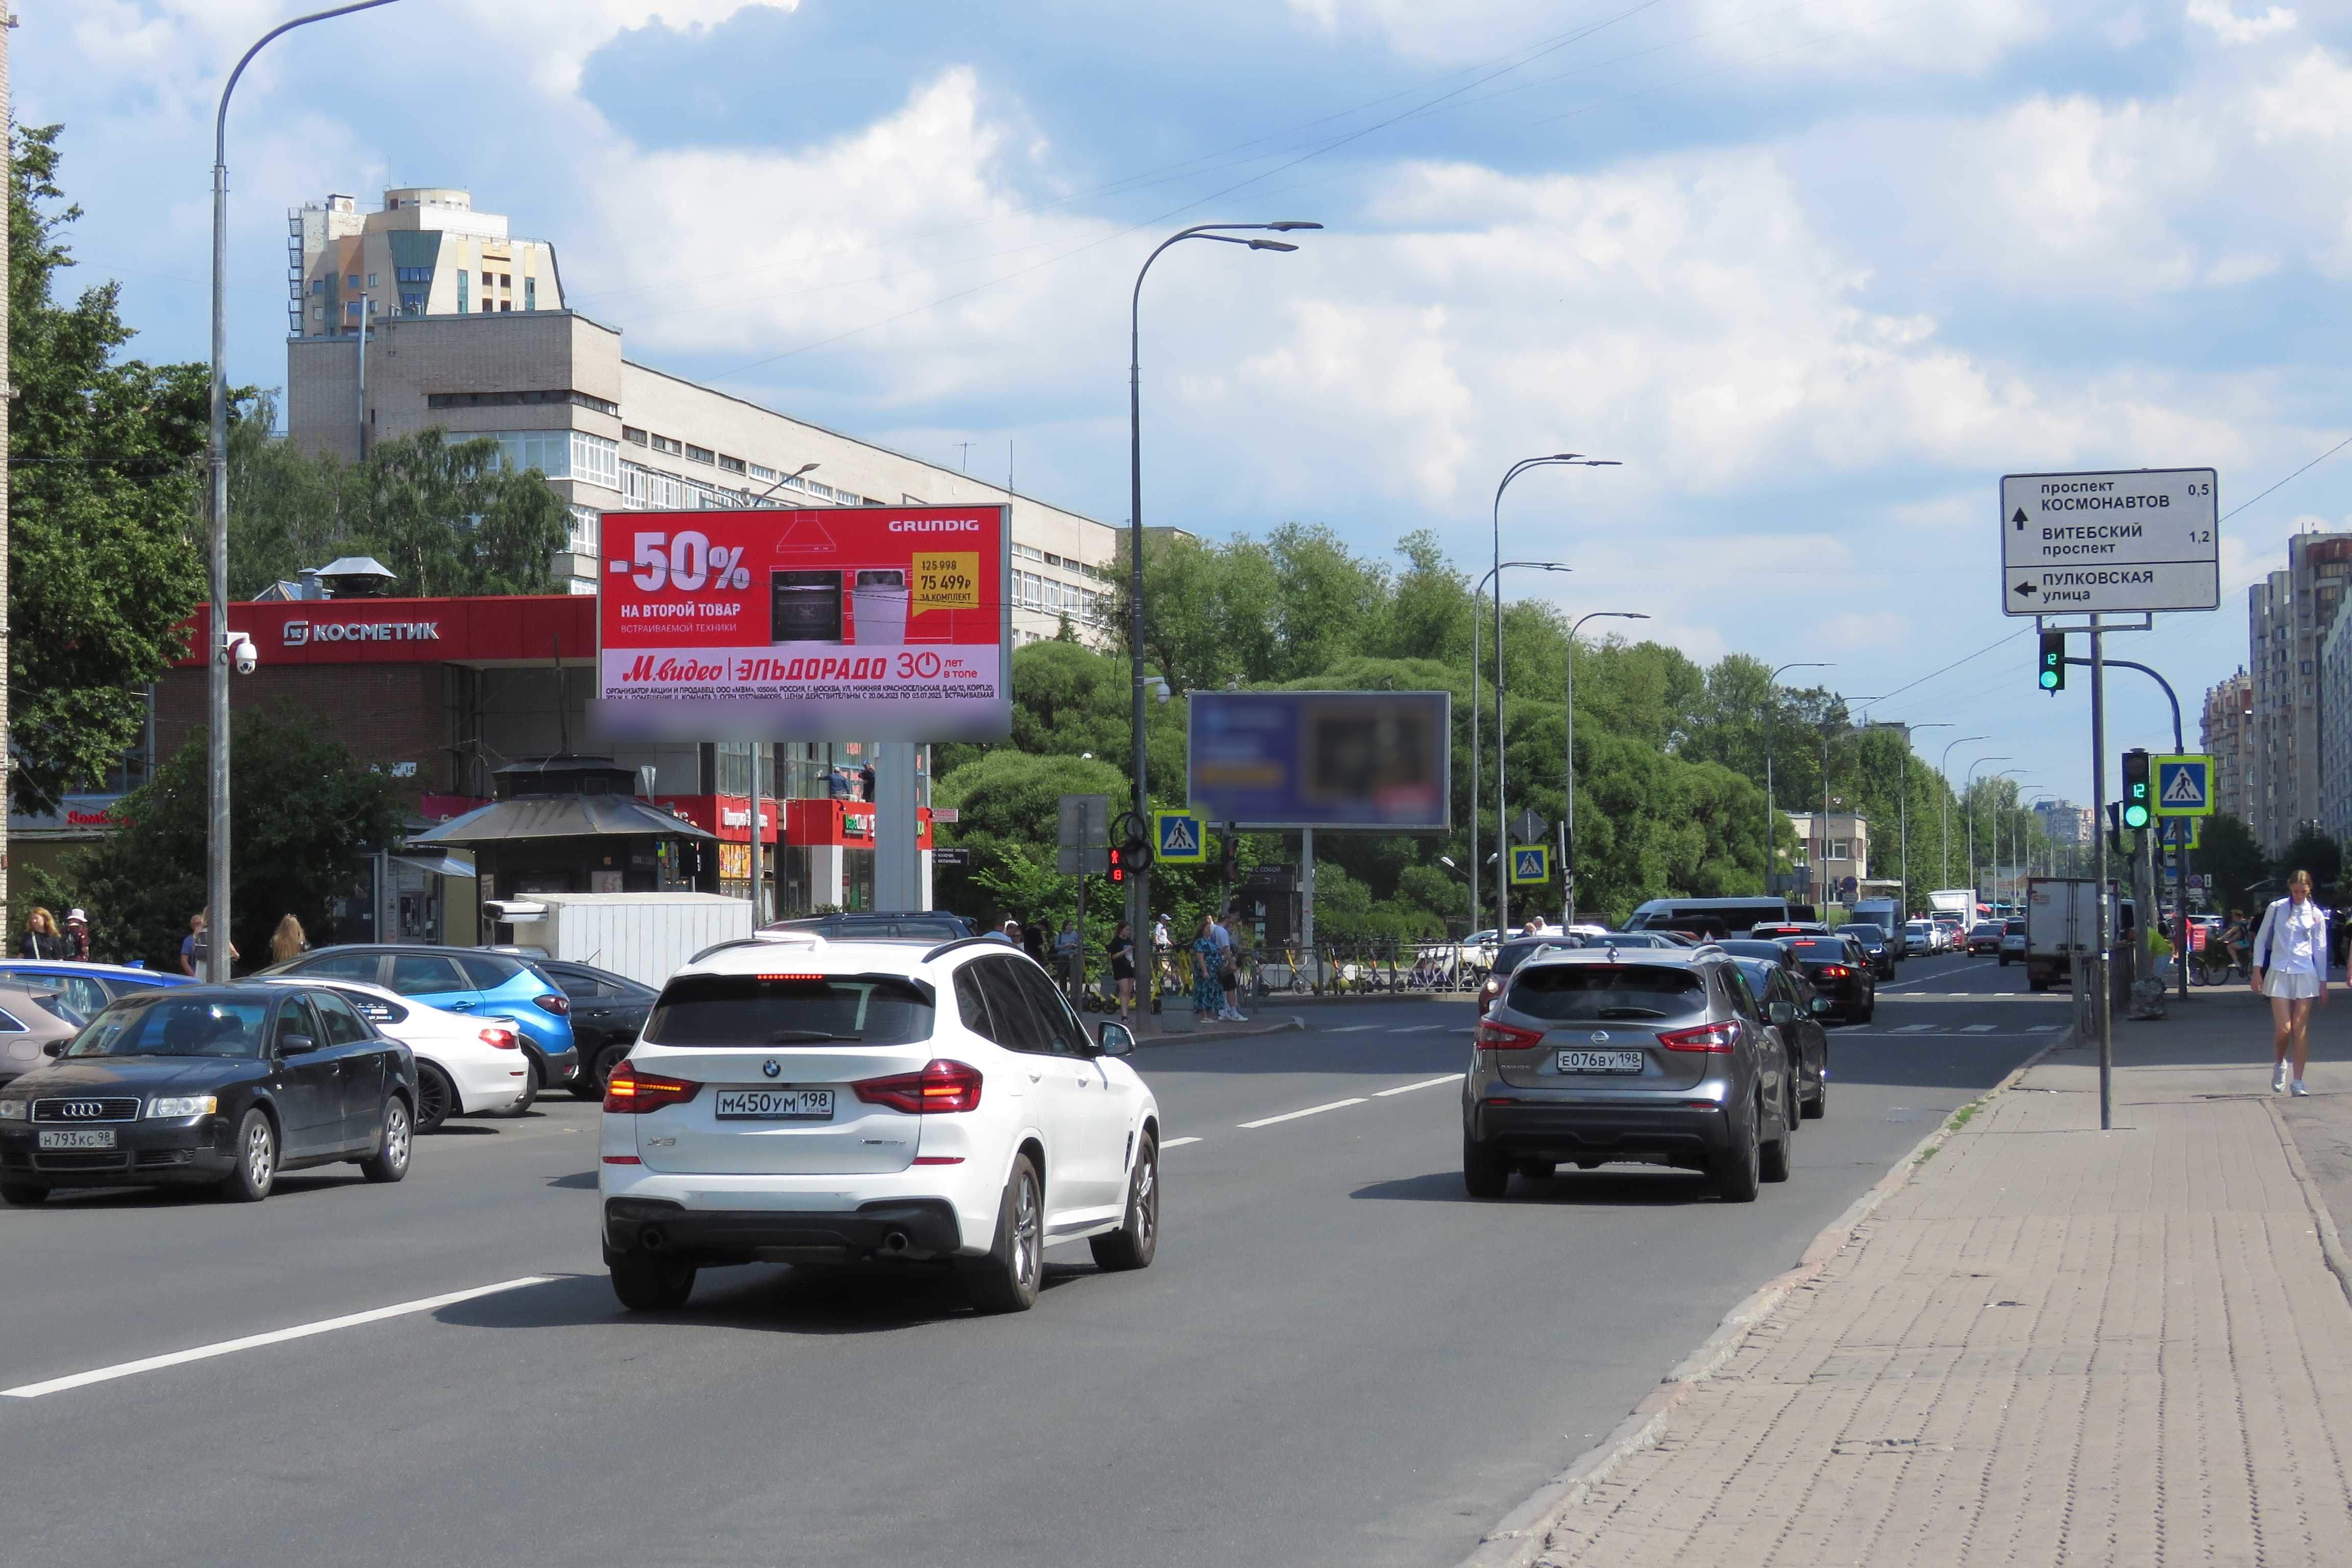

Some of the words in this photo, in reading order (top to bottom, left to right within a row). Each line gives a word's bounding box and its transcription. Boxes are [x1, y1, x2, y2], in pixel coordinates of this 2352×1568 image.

[2041, 481, 2114, 495] проспект
[2188, 484, 2209, 498] 0,5
[2041, 495, 2170, 511] КОСМОНАВТОВ
[888, 520, 979, 532] GRUNDIG
[2042, 522, 2142, 540] ВИТЕБСКИЙ
[2189, 531, 2210, 545] 1,2
[2042, 543, 2116, 557] проспект
[609, 531, 750, 591] -50%
[921, 576, 937, 590] 75
[2043, 571, 2153, 586] ПУЛКОВСКАЯ
[932, 593, 971, 601] КОМПЛЕКТ
[2043, 590, 2091, 604] улица
[621, 604, 640, 617] НА
[643, 601, 695, 617] ВТОРОЙ
[698, 603, 741, 617] ТОВАР
[313, 622, 440, 642] КОСМЕТИК
[621, 623, 693, 633] ВСТРАИВАЕМОЙ
[696, 623, 737, 632] ТЕХНИКИ
[896, 651, 942, 679] 30
[944, 659, 964, 667] лет
[2048, 654, 2056, 665] 12
[622, 655, 723, 682] М.видео
[735, 658, 887, 680] ЭЛЬДОРАДО
[953, 670, 978, 679] топе
[2134, 784, 2145, 798] 12
[1562, 1053, 1615, 1067] Е076ВУ
[1619, 1053, 1638, 1063] 198
[723, 1093, 796, 1113] М450УМ
[800, 1092, 827, 1107] 198
[44, 1133, 94, 1146] Н793КС
[98, 1132, 110, 1141] 98
